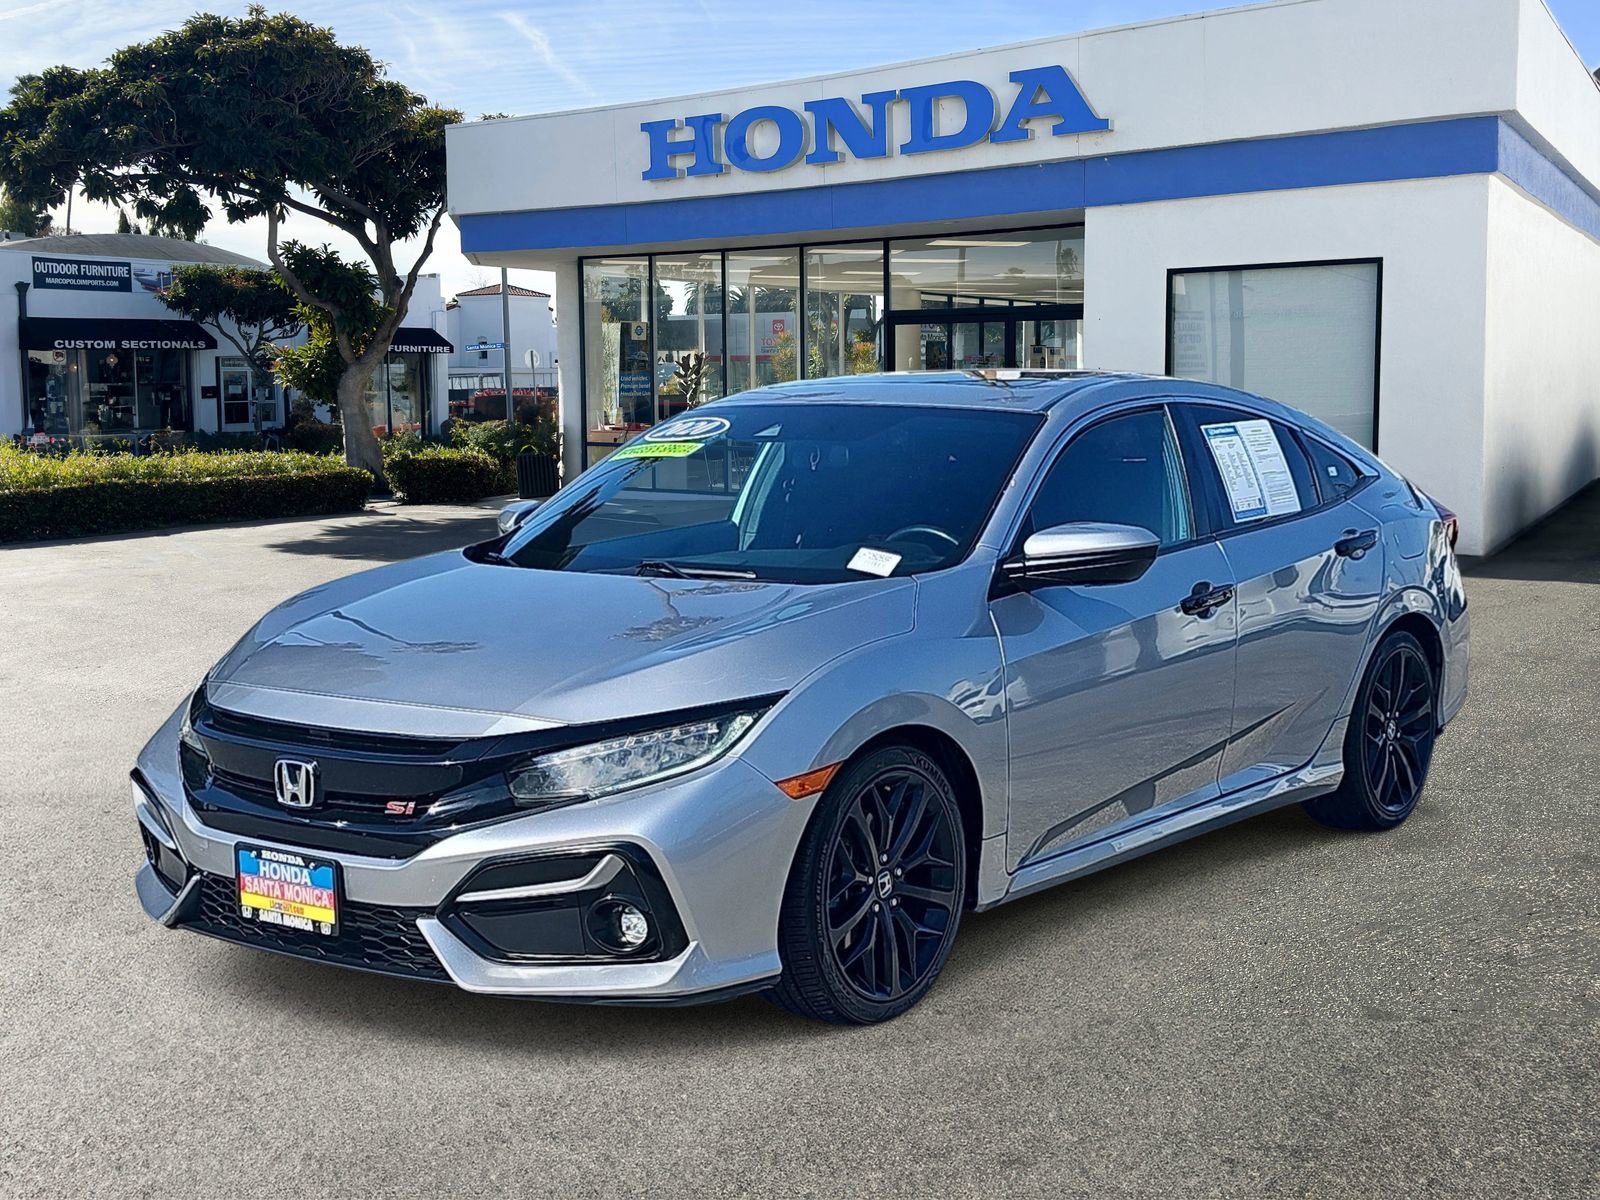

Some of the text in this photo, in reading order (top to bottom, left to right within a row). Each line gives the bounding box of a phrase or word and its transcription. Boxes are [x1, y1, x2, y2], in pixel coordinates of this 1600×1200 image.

[640, 64, 1111, 182] HONDA
[34, 261, 130, 278] OUTDOOR FURNITURE
[45, 277, 119, 287] MARCOPOLOIMPORTS.COM
[54, 339, 206, 349] CUSTOM SECTIONALS
[388, 344, 450, 353] FURNITURE
[260, 849, 305, 866] HONDA
[259, 860, 312, 886] HONDA
[244, 876, 331, 908] SANTA MONICA
[259, 909, 314, 932] SANTA MONICA
